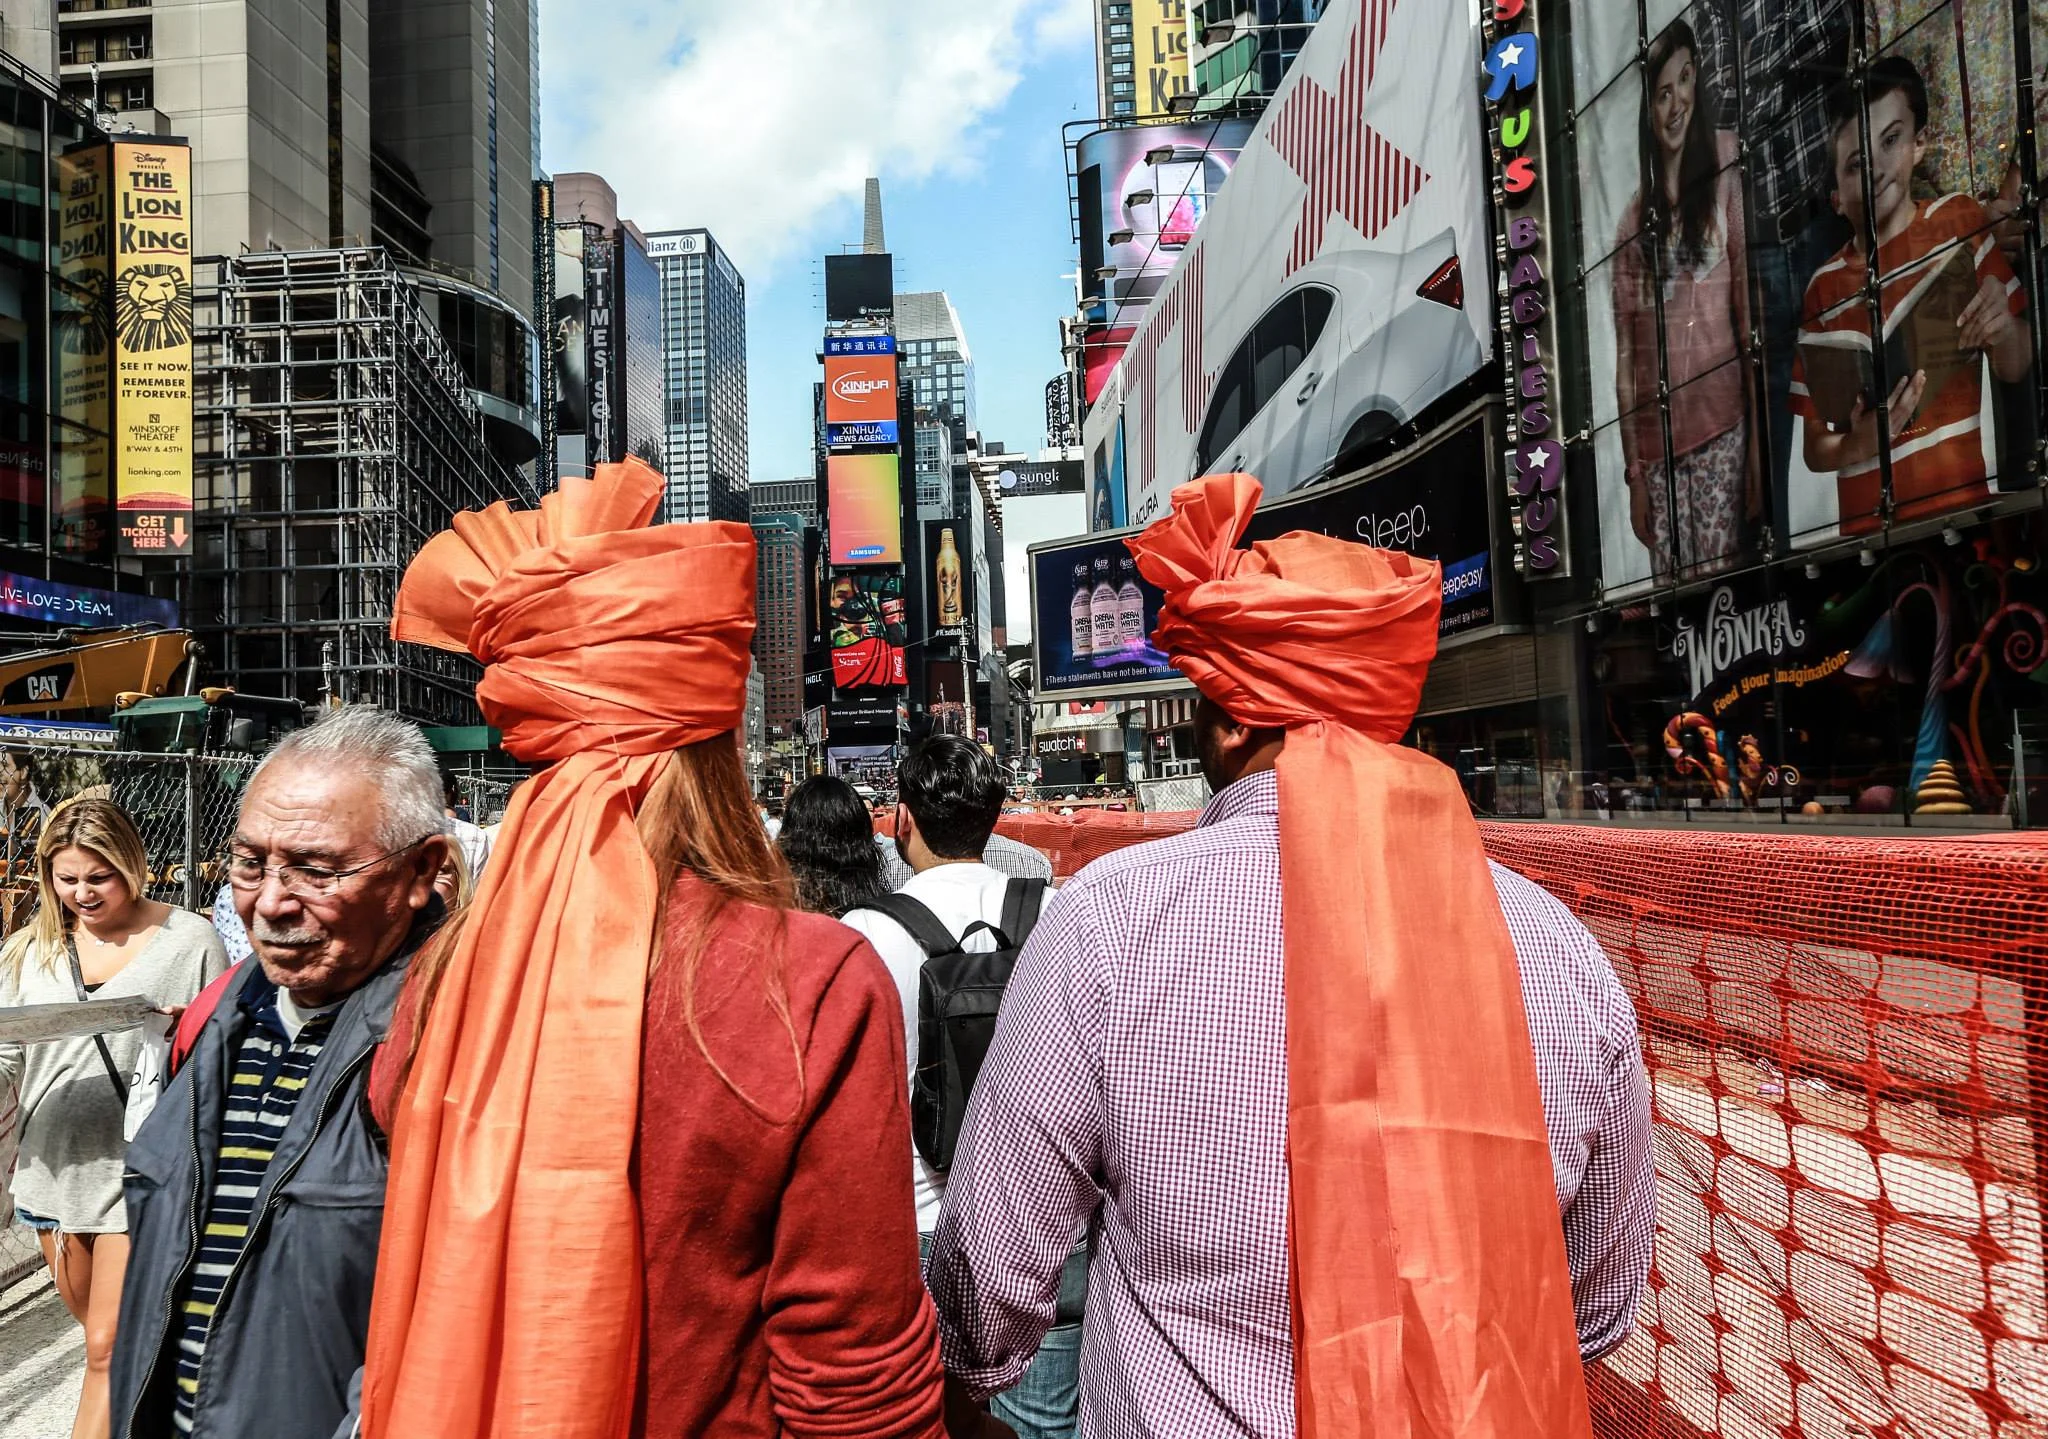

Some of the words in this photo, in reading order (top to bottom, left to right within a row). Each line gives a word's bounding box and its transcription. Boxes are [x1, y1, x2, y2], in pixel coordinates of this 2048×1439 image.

[132, 152, 166, 165] Disney
[129, 172, 172, 188] THE
[123, 192, 181, 219] LION
[119, 223, 188, 254] KING
[589, 268, 609, 368] TIMES
[120, 363, 139, 371] SEE
[143, 363, 153, 371] IT
[158, 363, 191, 372] NOW.
[124, 378, 185, 387] REMEMBER
[840, 380, 889, 391] XINHUA
[122, 390, 132, 398] IT
[136, 390, 191, 399] FOREVER.
[129, 425, 181, 433] MINSKOFF
[842, 426, 883, 435] XINHUA
[134, 433, 175, 441] THEATRE
[833, 435, 856, 443] NEWS
[858, 434, 892, 442] AGENCY
[128, 467, 181, 478] lionking.com
[1135, 492, 1159, 526] ACURA
[137, 516, 166, 527] GET
[122, 528, 166, 537] TICKETS
[133, 537, 166, 548] HERE
[0, 585, 22, 603] LIVE
[27, 591, 61, 609] LOVE
[65, 598, 114, 616] DREAM.
[1095, 612, 1115, 622] DREAM
[1120, 611, 1140, 620] DREAM
[1095, 621, 1115, 629] WATER
[1120, 619, 1140, 627] WATER
[1673, 586, 1805, 701] WONKA
[1068, 671, 1101, 682] statements
[1103, 669, 1118, 678] have
[1119, 667, 1130, 677] not
[1132, 667, 1147, 676] been
[27, 675, 58, 700] CAT
[1713, 685, 1740, 715] Feed
[1741, 672, 1770, 694] your
[1039, 736, 1076, 753] swatch
